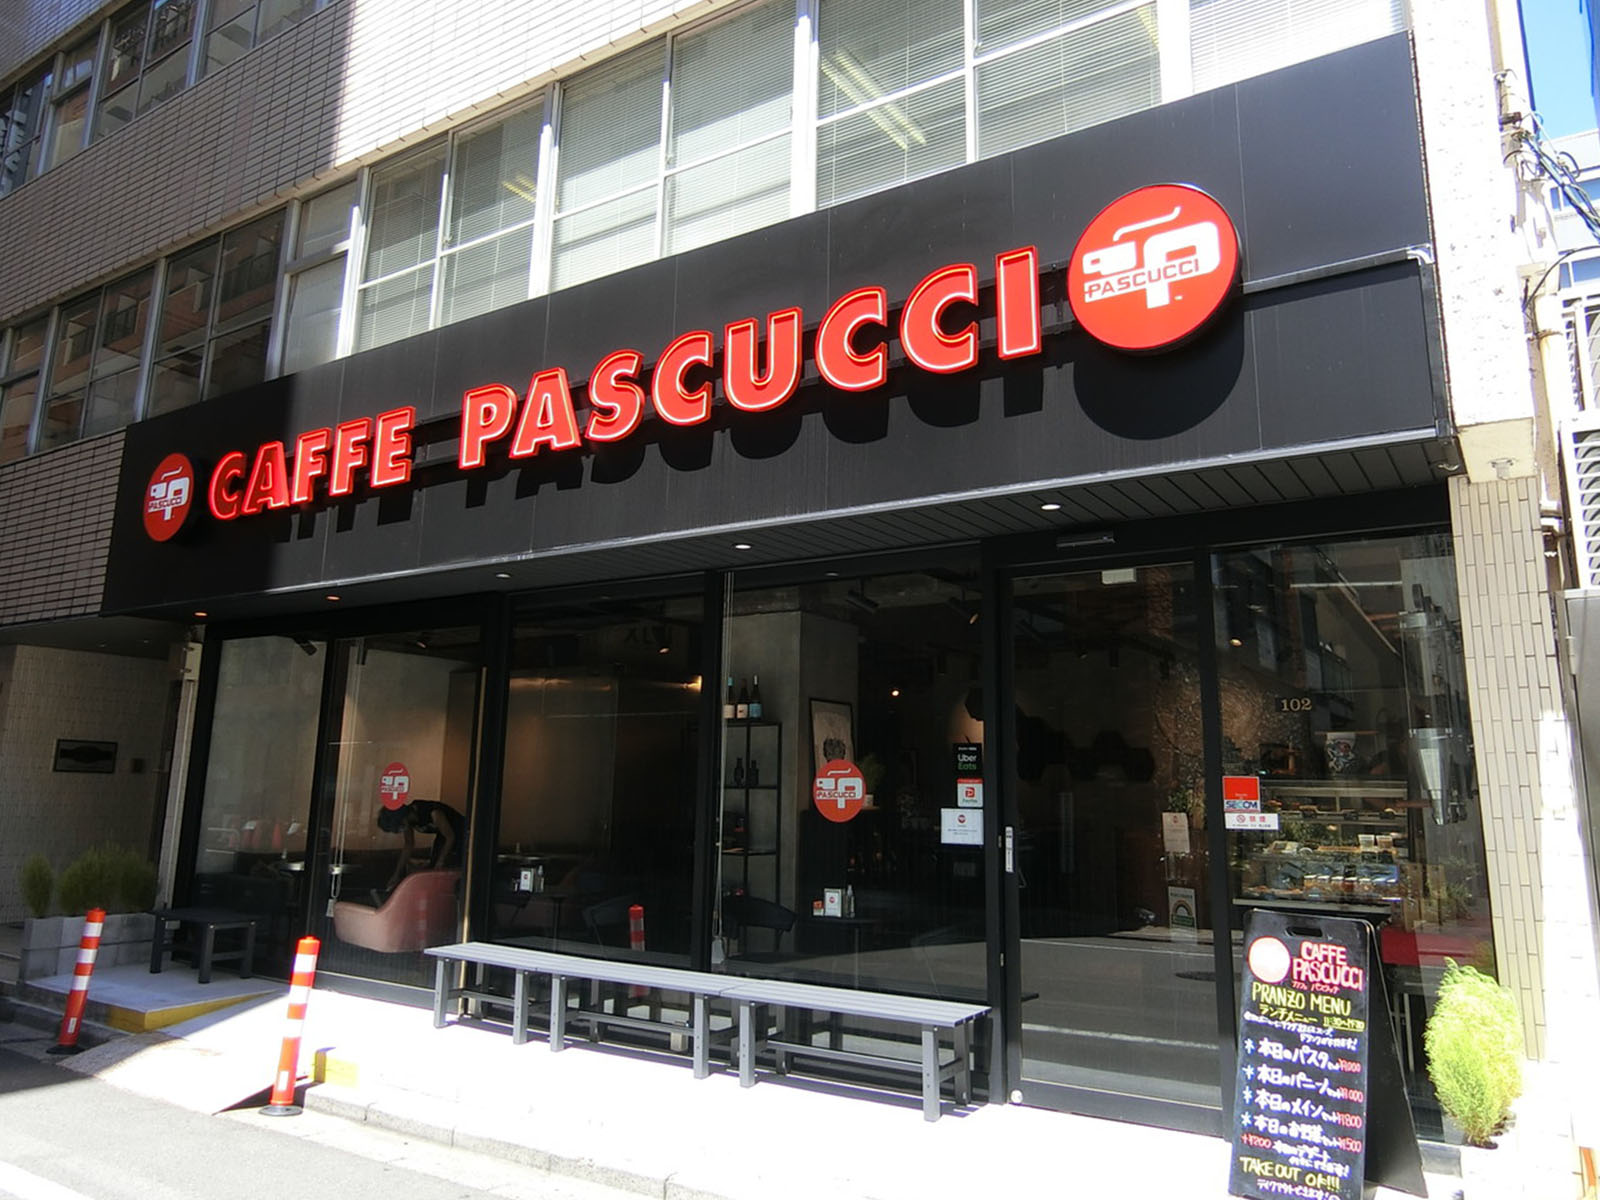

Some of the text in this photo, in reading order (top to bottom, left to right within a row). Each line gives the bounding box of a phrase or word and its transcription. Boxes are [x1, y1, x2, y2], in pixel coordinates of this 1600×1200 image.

[1086, 258, 1200, 298] PASCUCCI
[208, 245, 1042, 521] CAFFE PASCUCCI
[1281, 697, 1312, 711] 102
[957, 753, 977, 762] Uber
[957, 762, 977, 770] Eats
[1225, 800, 1258, 809] SECOM
[1300, 941, 1347, 966] CAFFE
[1291, 957, 1364, 992] PASCUCCI
[1252, 982, 1351, 1017] PRANZO MENU
[1239, 1156, 1274, 1177] TAKE
[1274, 1163, 1302, 1182] OUT
